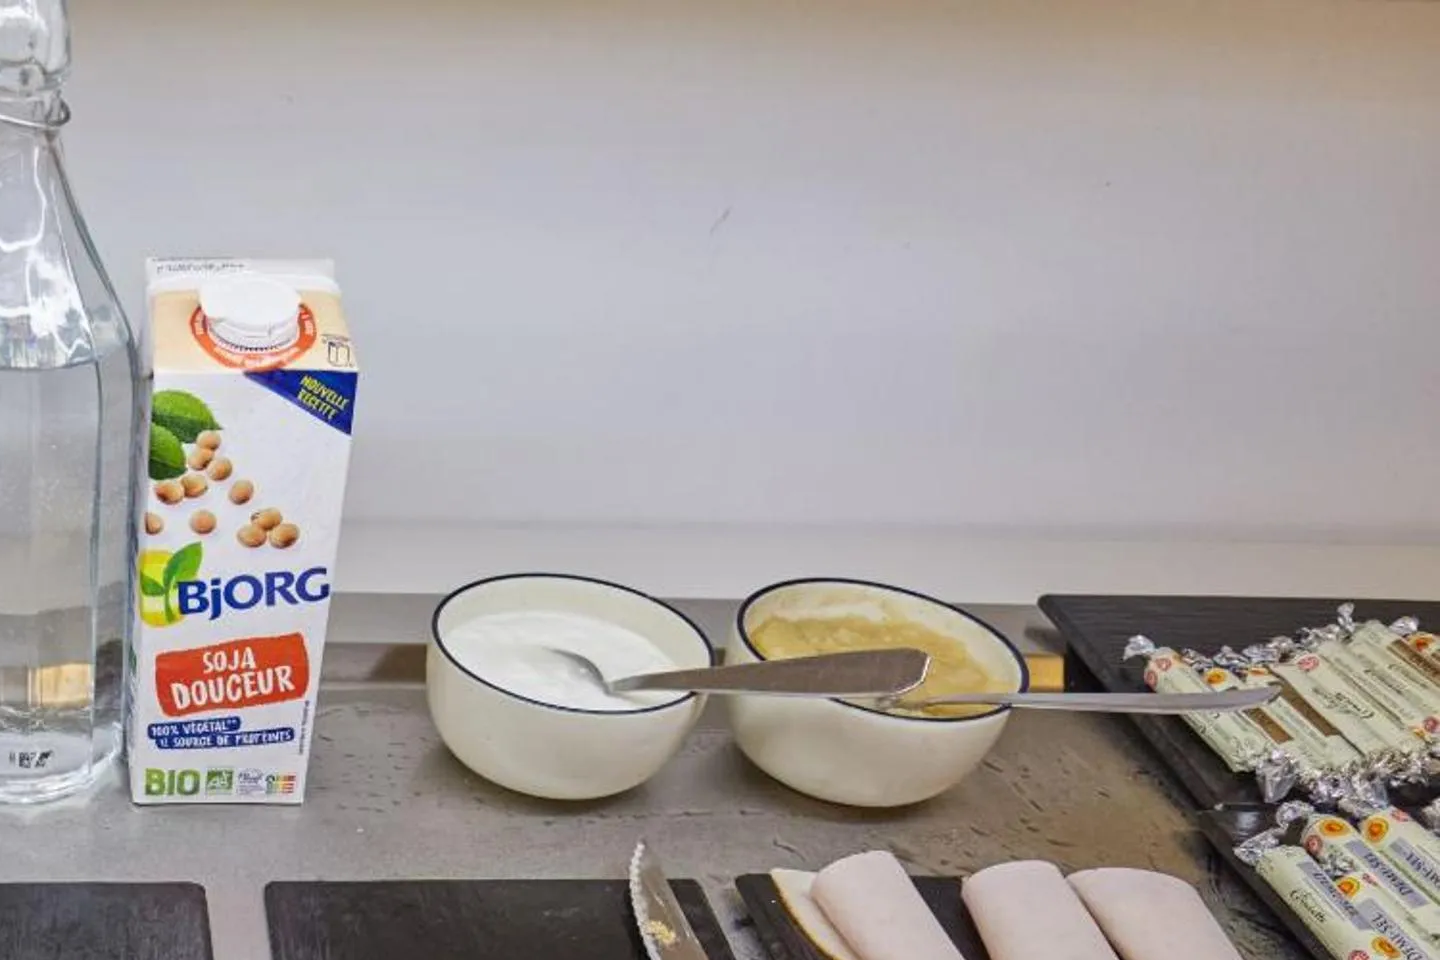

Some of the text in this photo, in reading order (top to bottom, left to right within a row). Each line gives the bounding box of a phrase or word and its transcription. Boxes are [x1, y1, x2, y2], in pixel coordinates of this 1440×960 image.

[297, 387, 338, 420] RECETTE
[301, 375, 350, 411] NOUVELLE
[177, 566, 331, 621] BjORG
[202, 646, 257, 674] SOJA
[169, 664, 297, 711] DOUCEUR
[151, 724, 180, 738] 100%
[174, 734, 213, 747] SOURCE
[216, 735, 230, 747] DE
[144, 767, 201, 797] BIO
